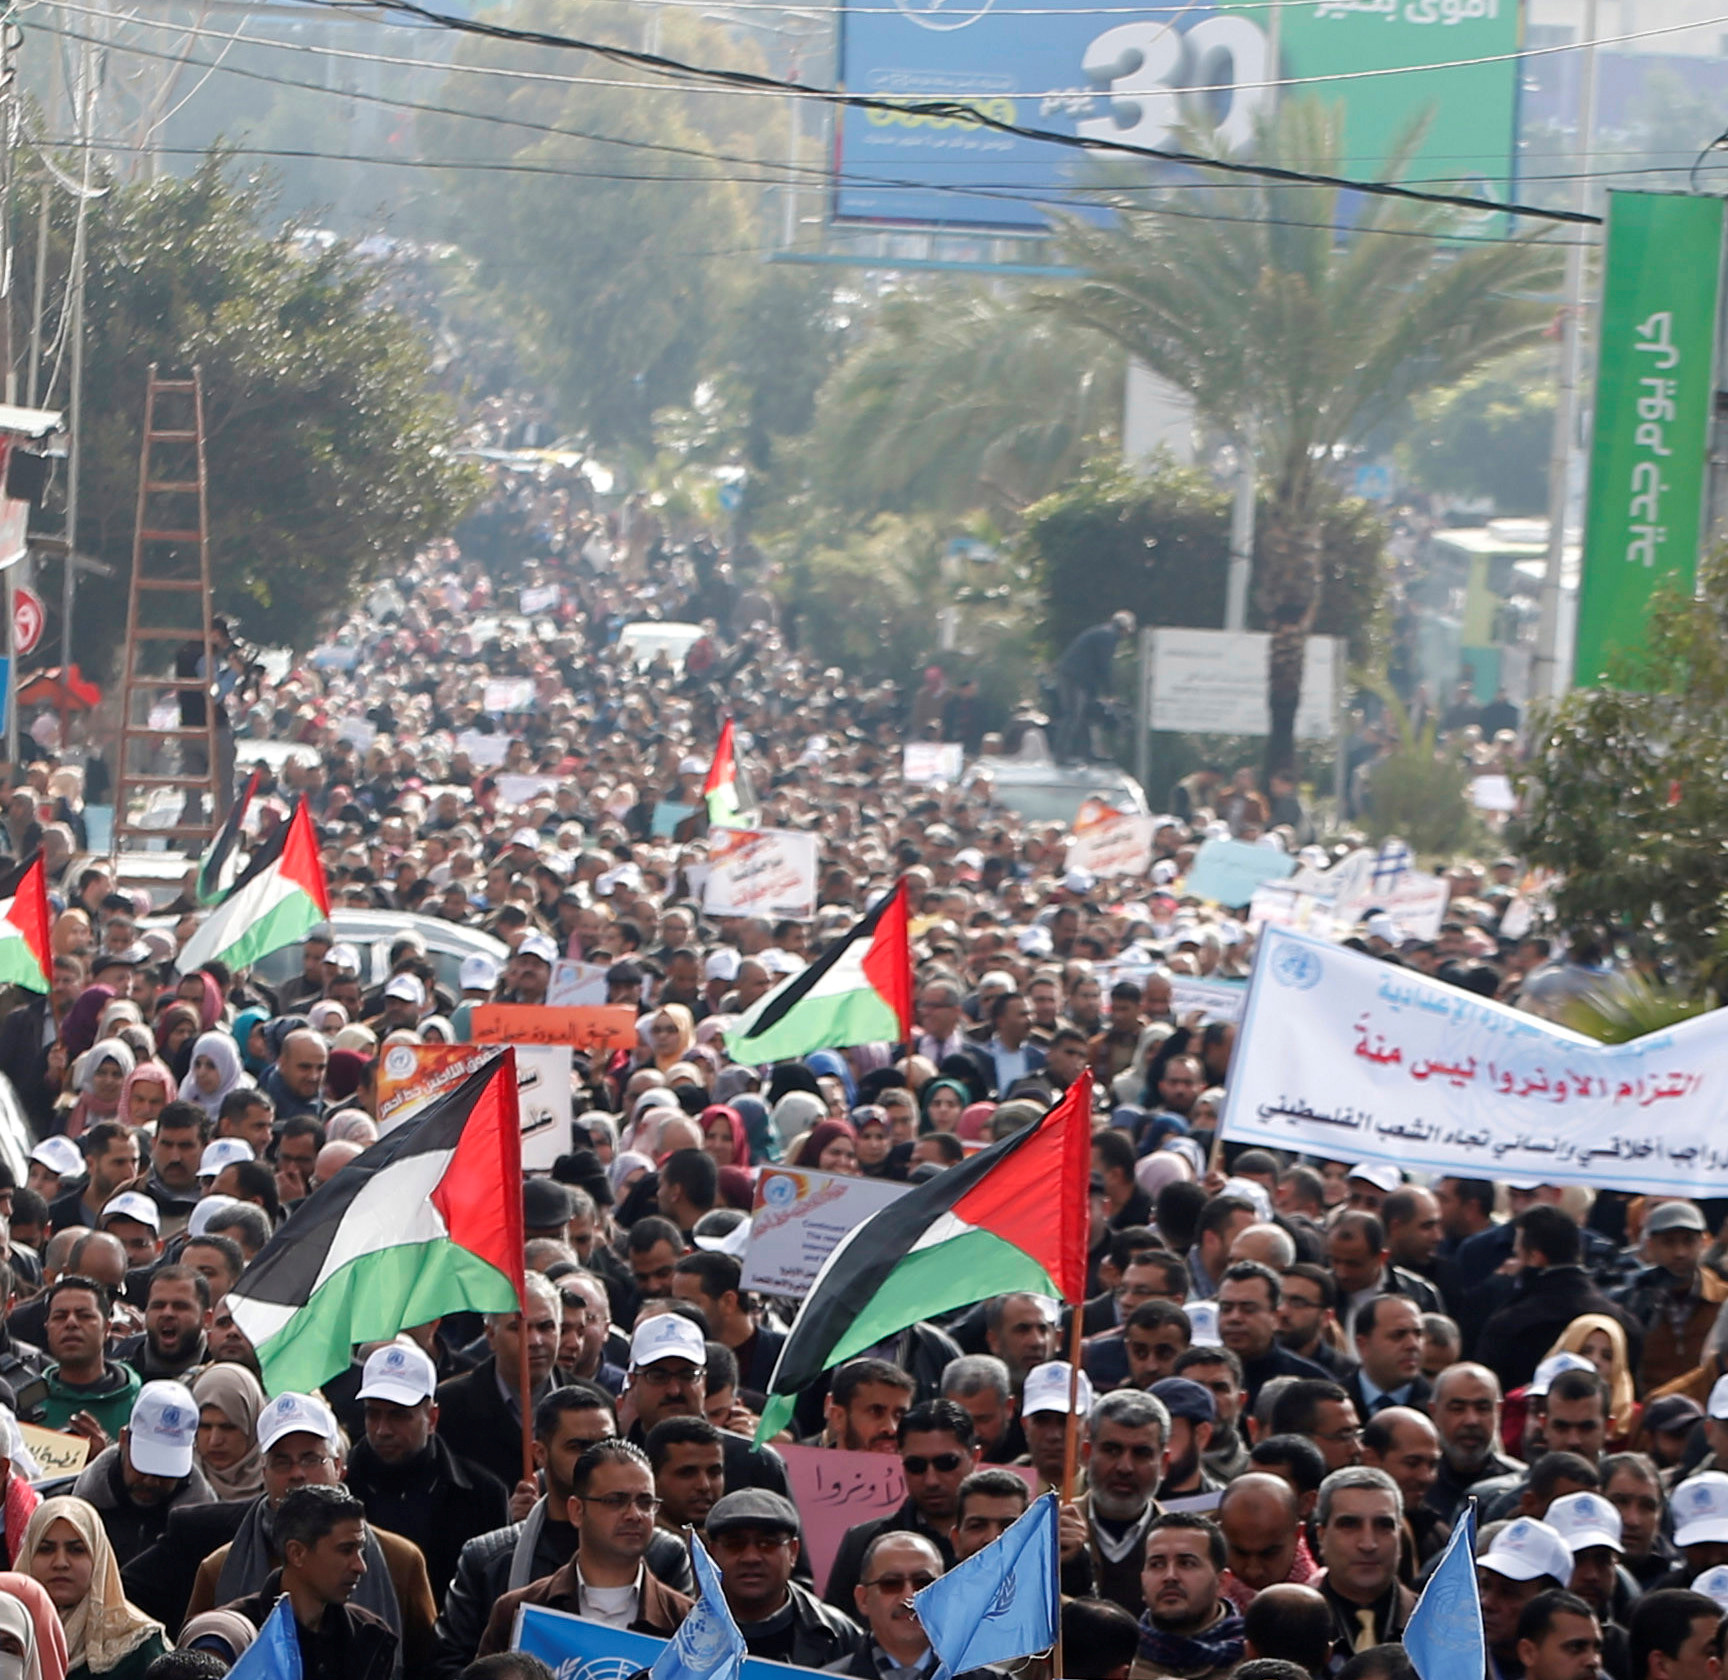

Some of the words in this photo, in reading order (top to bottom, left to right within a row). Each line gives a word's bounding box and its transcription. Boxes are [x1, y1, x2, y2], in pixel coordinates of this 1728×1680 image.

[1075, 15, 1270, 158] 30
[1410, 1055, 1477, 1088] ليس
[1614, 1071, 1704, 1107] التزام
[1256, 1095, 1371, 1131] الفلسطيني
[1376, 1116, 1439, 1142] الشعب
